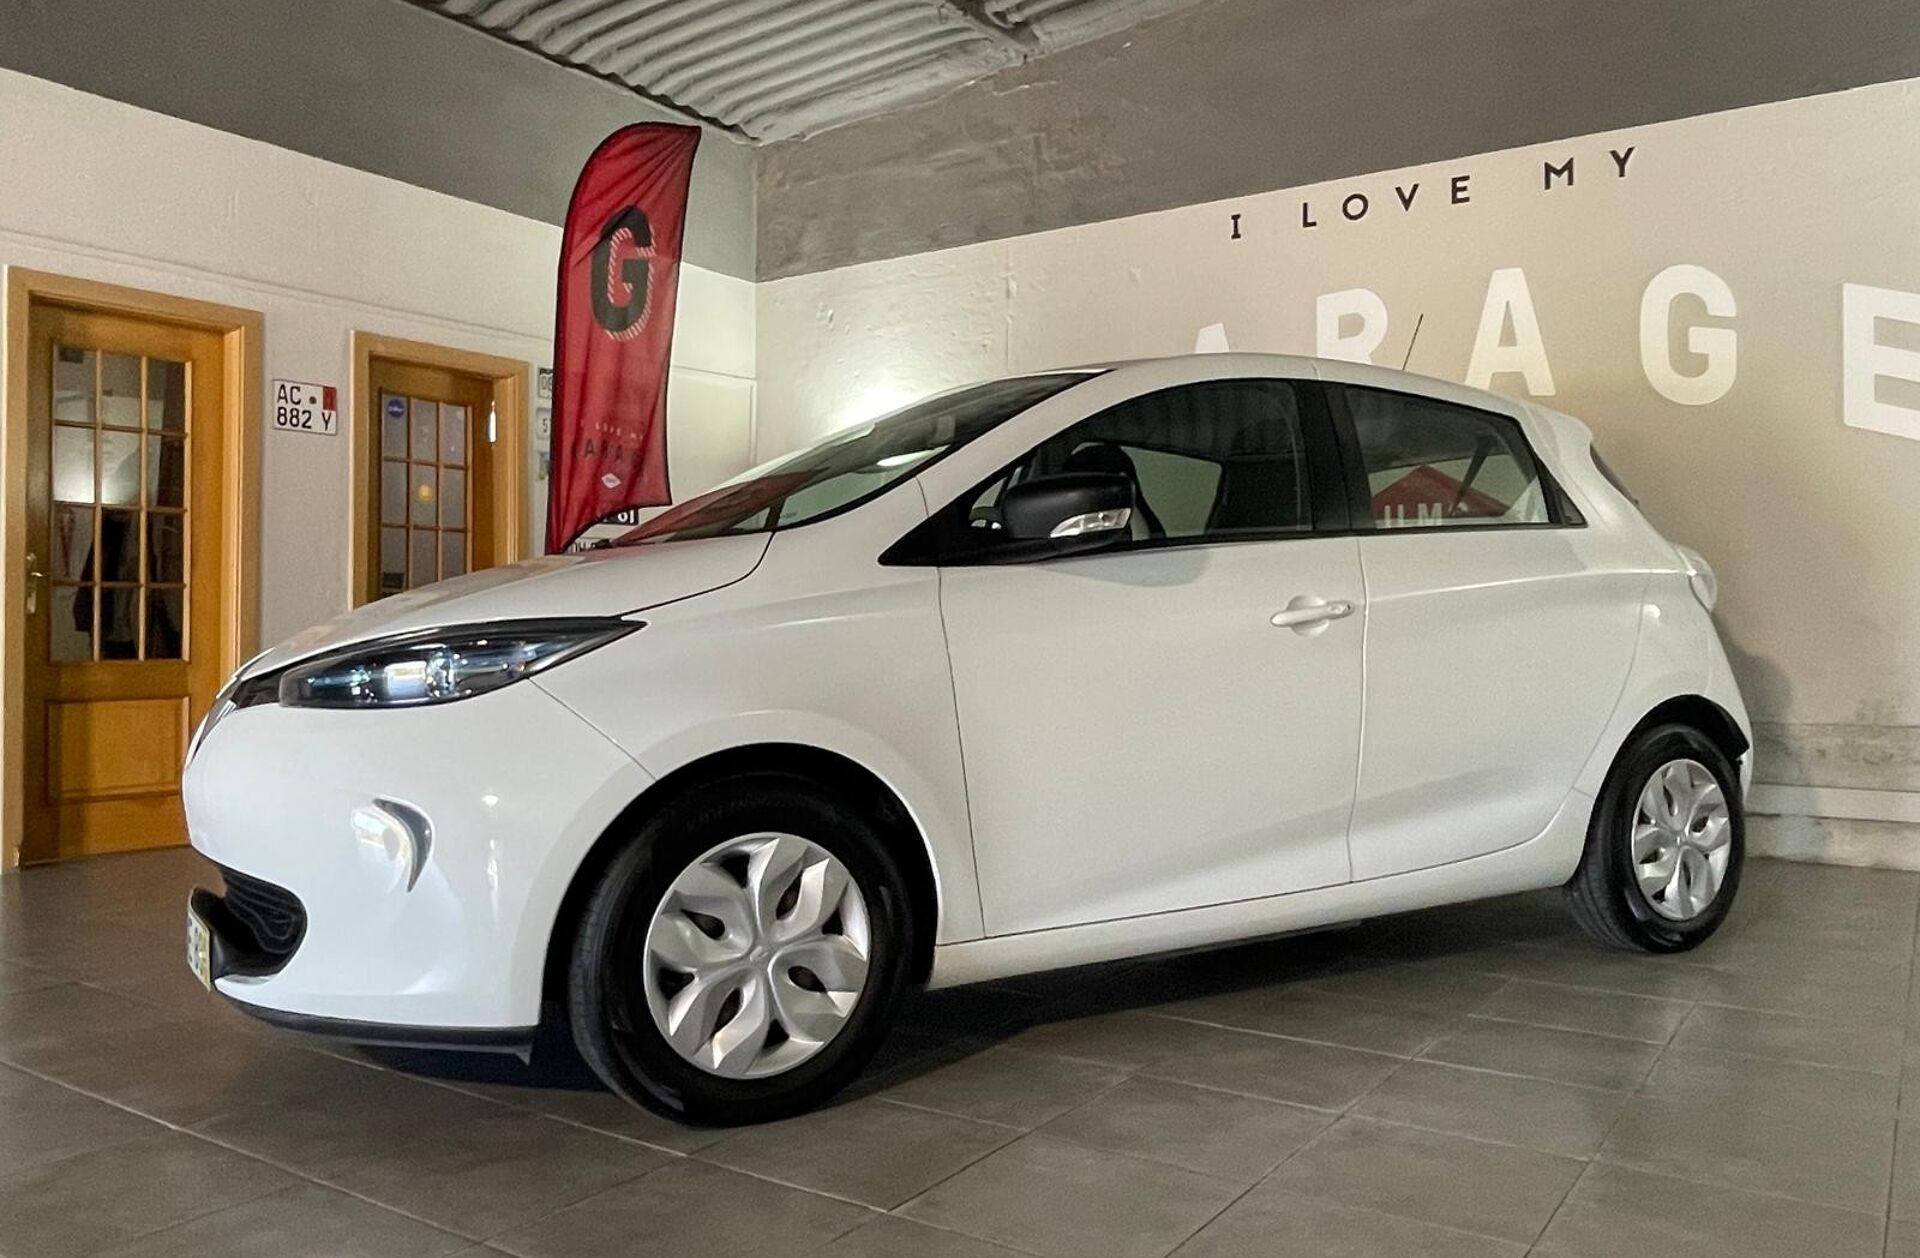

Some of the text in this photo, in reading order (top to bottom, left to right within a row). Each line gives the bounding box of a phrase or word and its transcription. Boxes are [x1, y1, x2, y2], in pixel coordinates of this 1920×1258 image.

[1230, 146, 1636, 240] I LOVE MY
[590, 204, 656, 341] G
[277, 383, 302, 406] AC
[1194, 263, 1920, 440] RAGE
[276, 406, 332, 432] 882 Y
